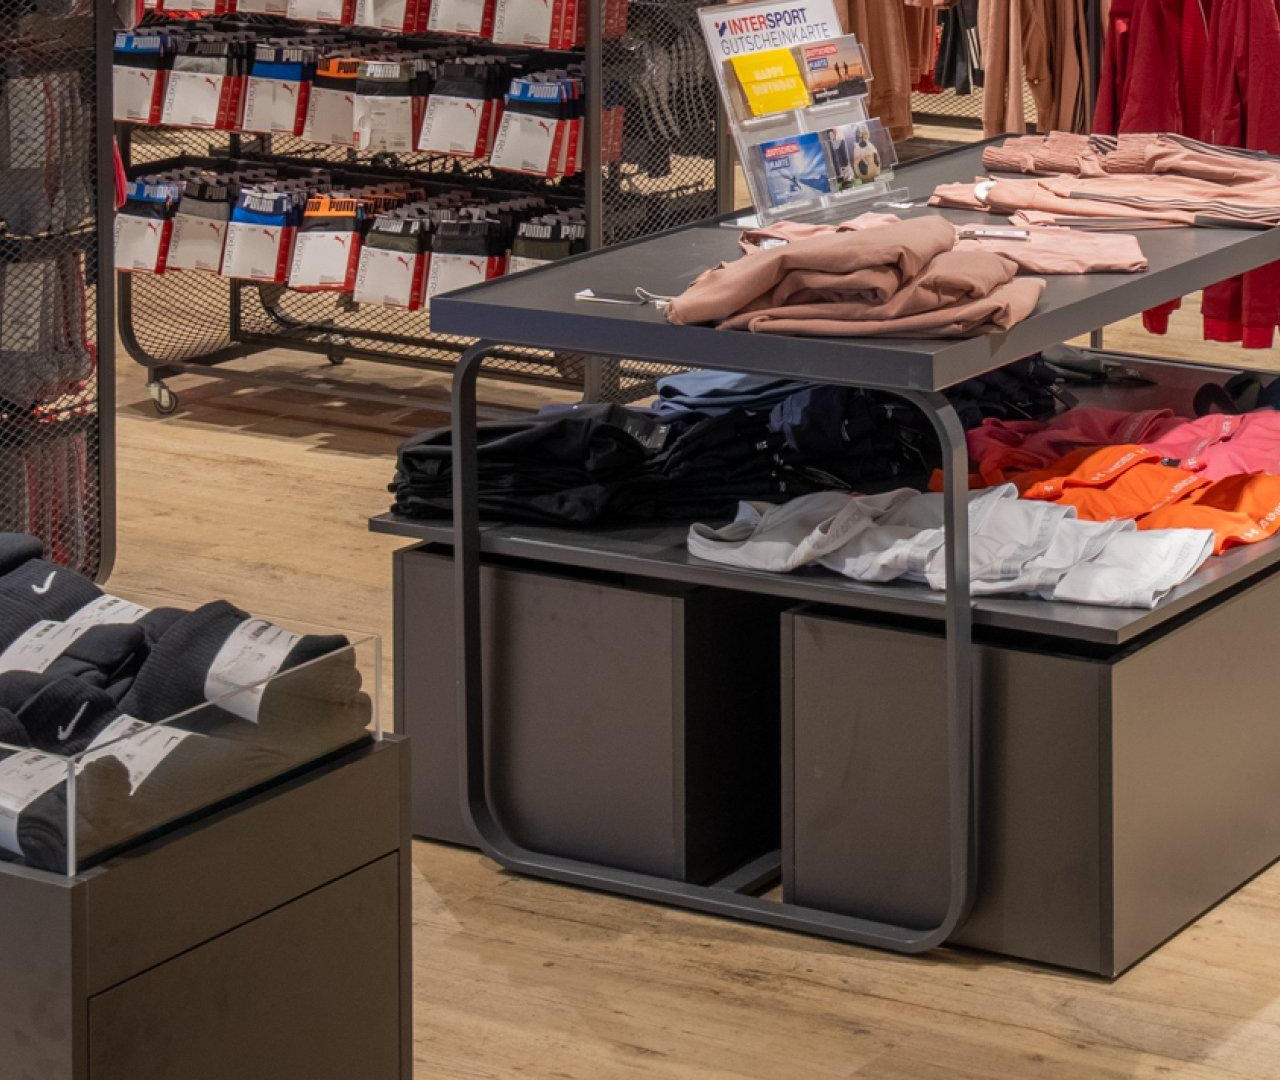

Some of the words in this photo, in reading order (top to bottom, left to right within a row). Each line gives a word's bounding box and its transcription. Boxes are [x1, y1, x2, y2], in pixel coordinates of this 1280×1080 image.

[727, 7, 807, 36] INTERSPORT
[720, 22, 831, 56] GUTSCHEINKARTE
[519, 222, 552, 239] PUMA
